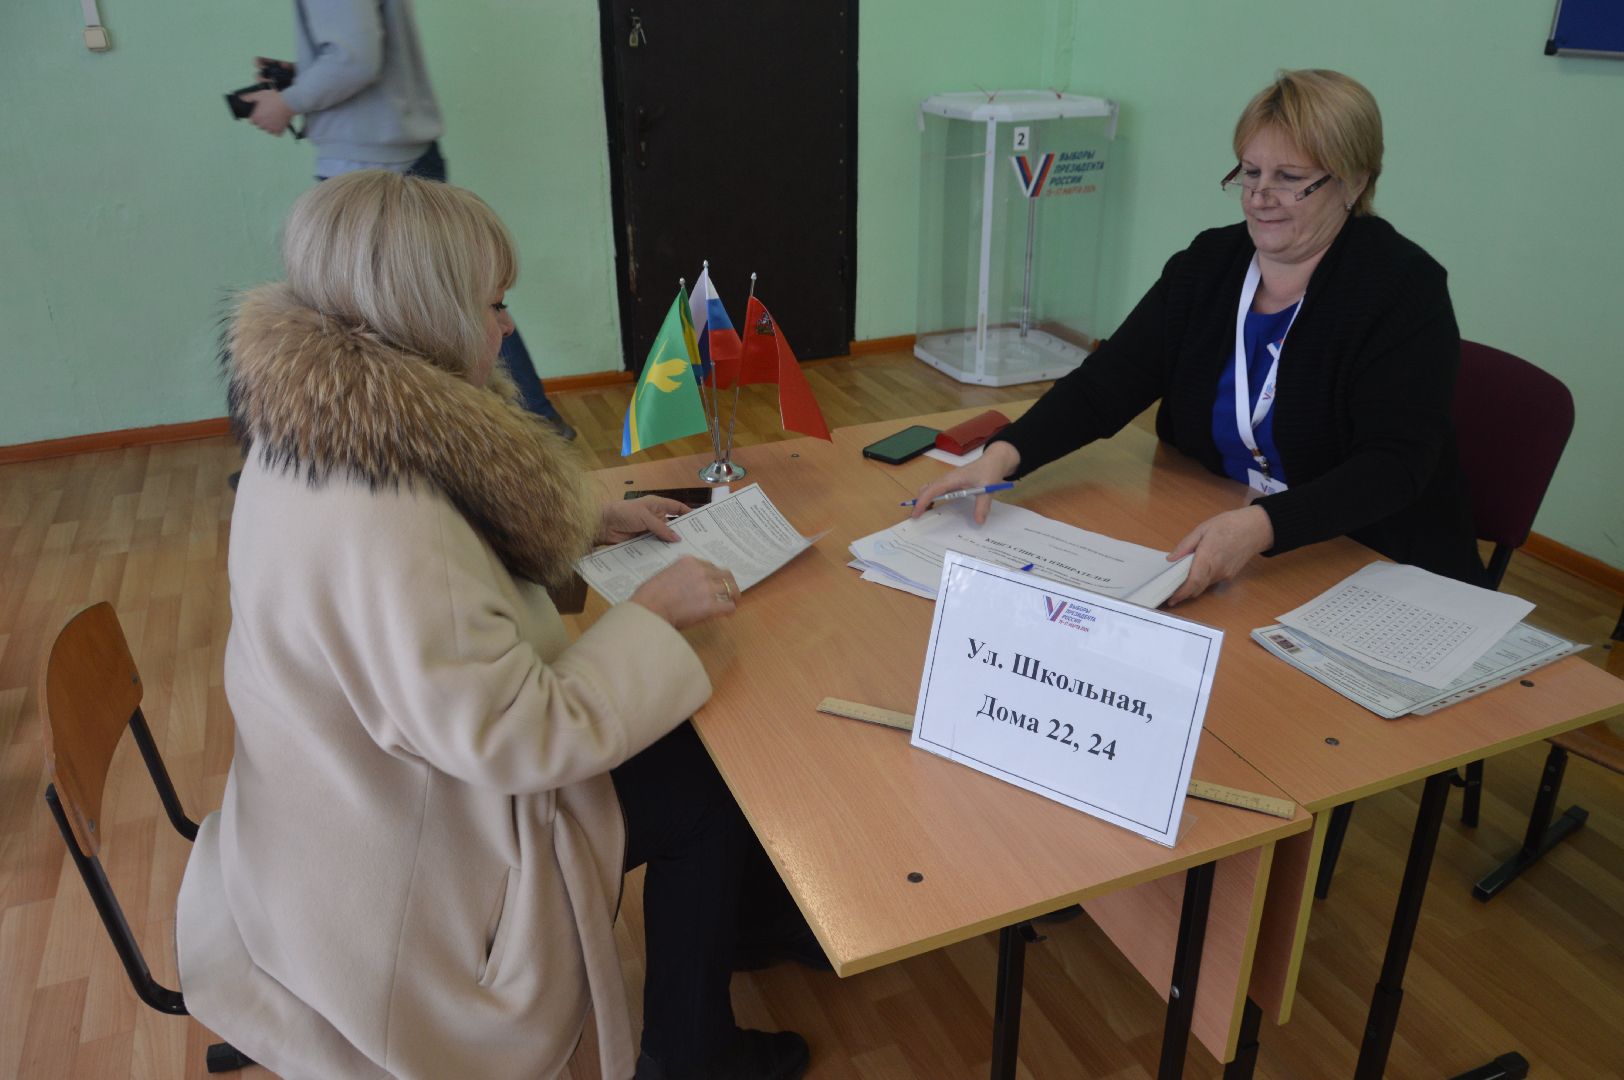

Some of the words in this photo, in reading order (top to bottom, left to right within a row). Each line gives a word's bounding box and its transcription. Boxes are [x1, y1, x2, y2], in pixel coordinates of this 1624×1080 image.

[1017, 132, 1025, 146] 2
[1060, 151, 1096, 160] ВЫБОРЫ
[1055, 162, 1104, 173] ПРЕЗИДЕНТА
[1049, 175, 1083, 186] РОССИИ
[1069, 603, 1092, 614] ВЫБОРЫ
[1061, 615, 1082, 624] РОССИИ
[1065, 609, 1096, 622] ПРЕЗИДЕНТА
[967, 638, 1003, 669] Ул.
[1011, 652, 1153, 723] Школьная,
[976, 694, 1039, 733] Дома
[1046, 718, 1080, 752] 22,
[1087, 733, 1116, 761] 24
